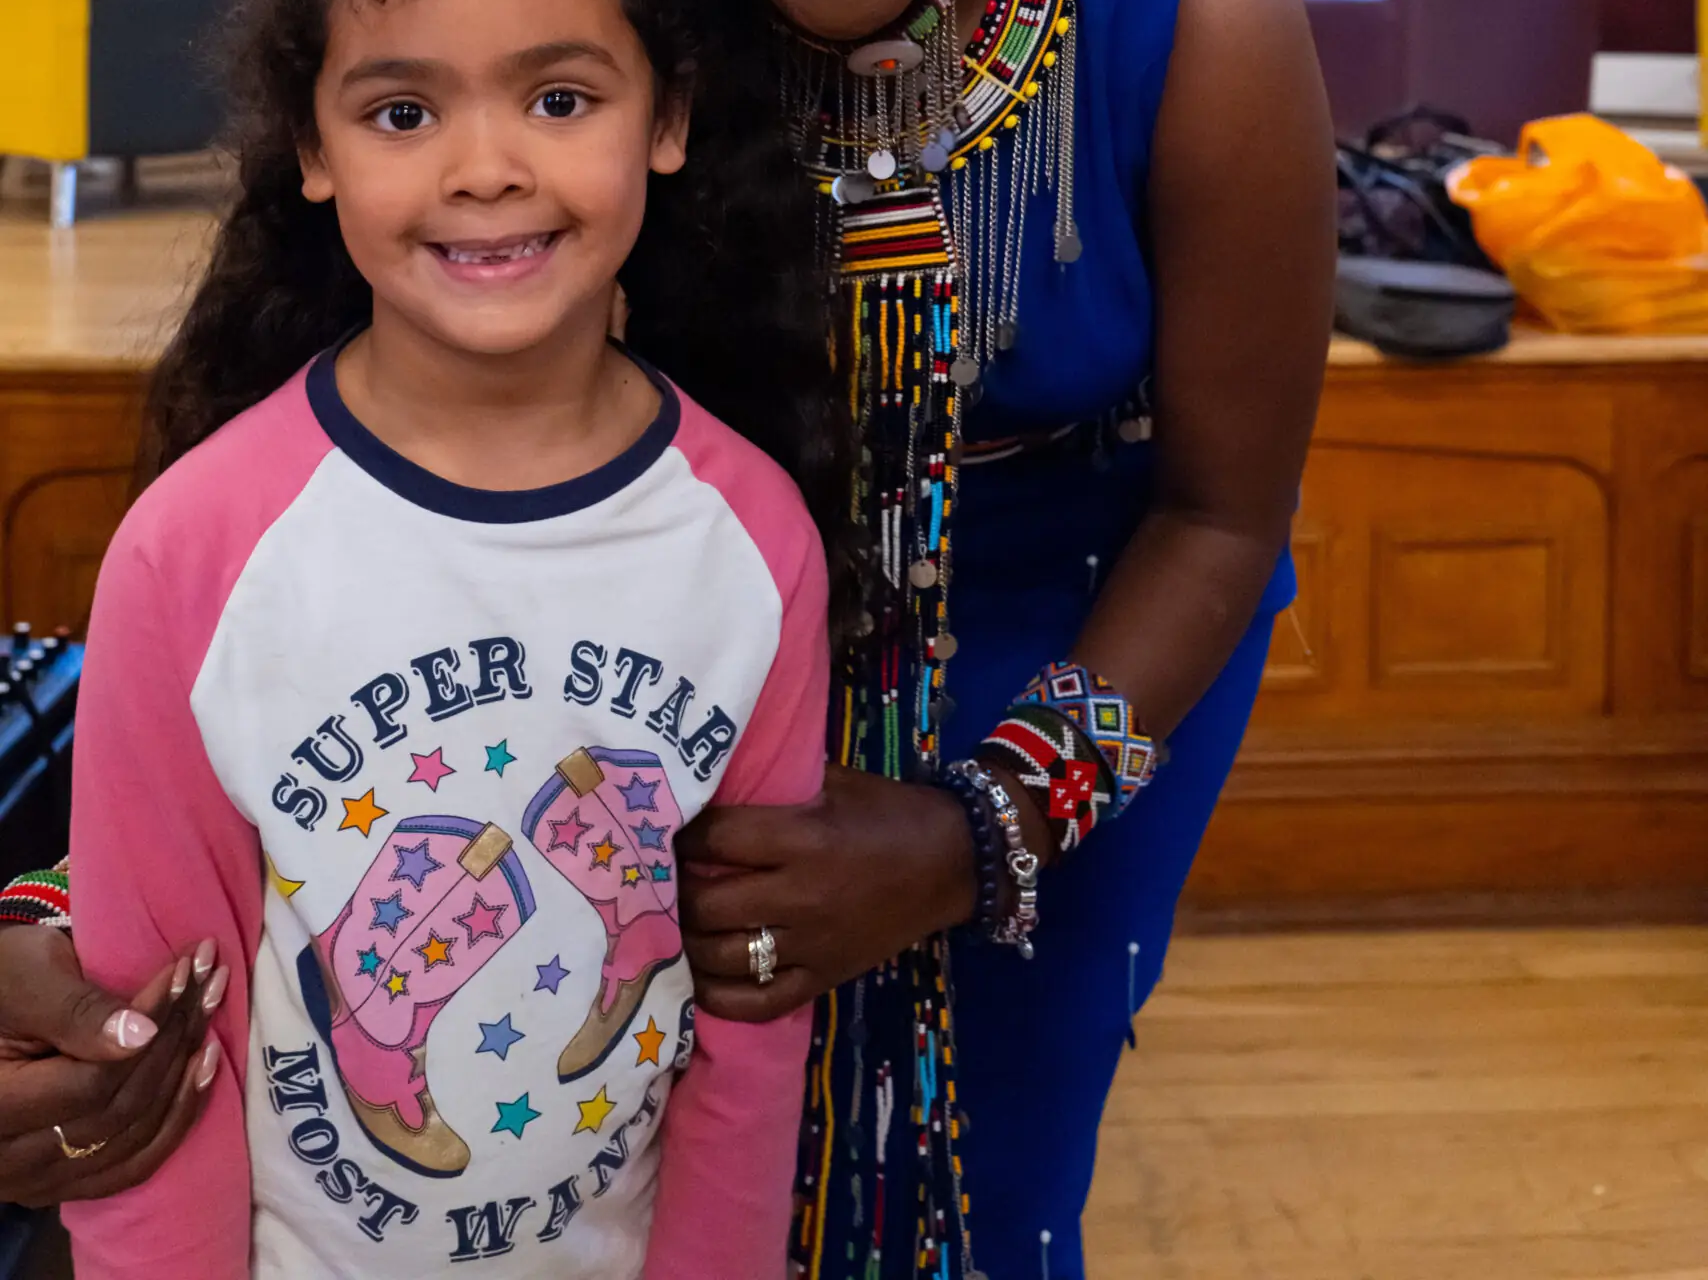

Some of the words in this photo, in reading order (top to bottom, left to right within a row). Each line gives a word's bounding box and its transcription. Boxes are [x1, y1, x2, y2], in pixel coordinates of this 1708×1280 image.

[272, 635, 532, 832] SUPER
[563, 640, 738, 782] STAR
[262, 1041, 419, 1243] MOST
